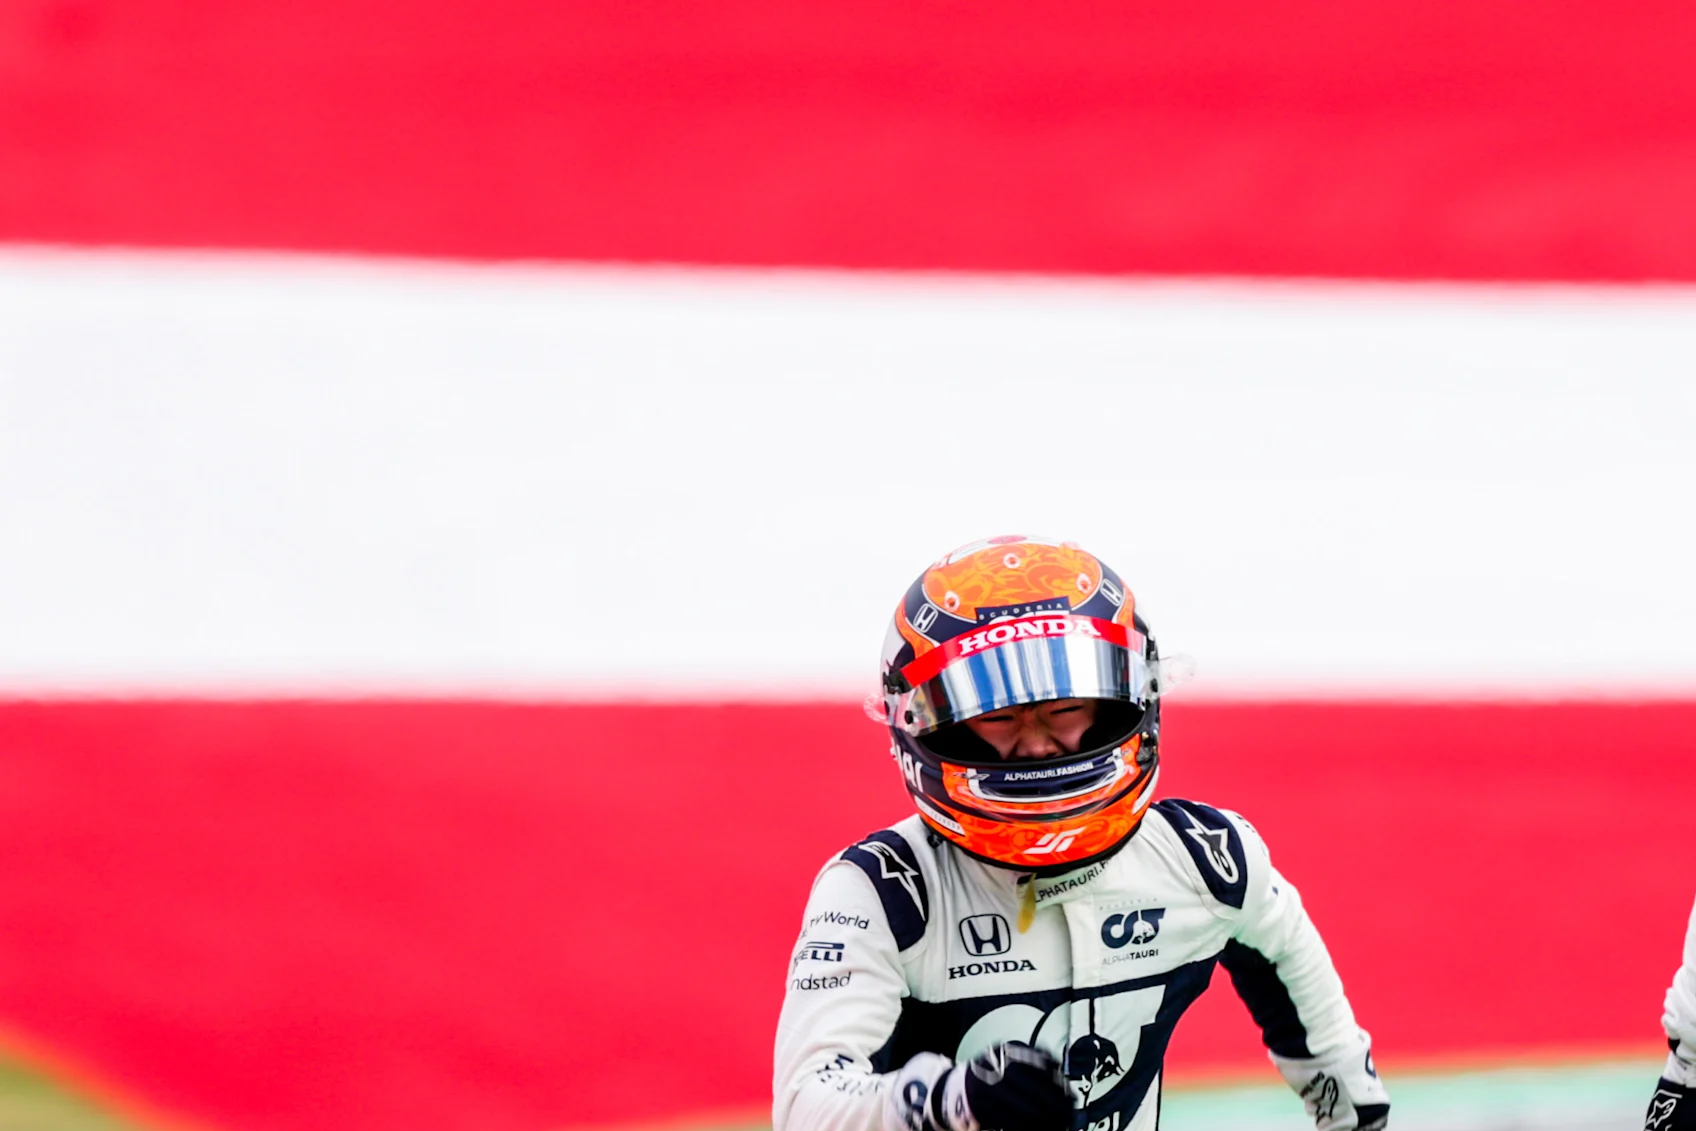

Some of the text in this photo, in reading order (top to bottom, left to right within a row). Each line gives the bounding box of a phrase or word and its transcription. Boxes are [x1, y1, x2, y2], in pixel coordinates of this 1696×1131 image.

[978, 602, 1064, 621] SCUDERIA
[959, 618, 1102, 656] HONDA
[1003, 761, 1095, 782] ALPHATAURI.FASHION
[1101, 948, 1159, 967] ALPHATAURI
[948, 959, 1037, 981] HONDA
